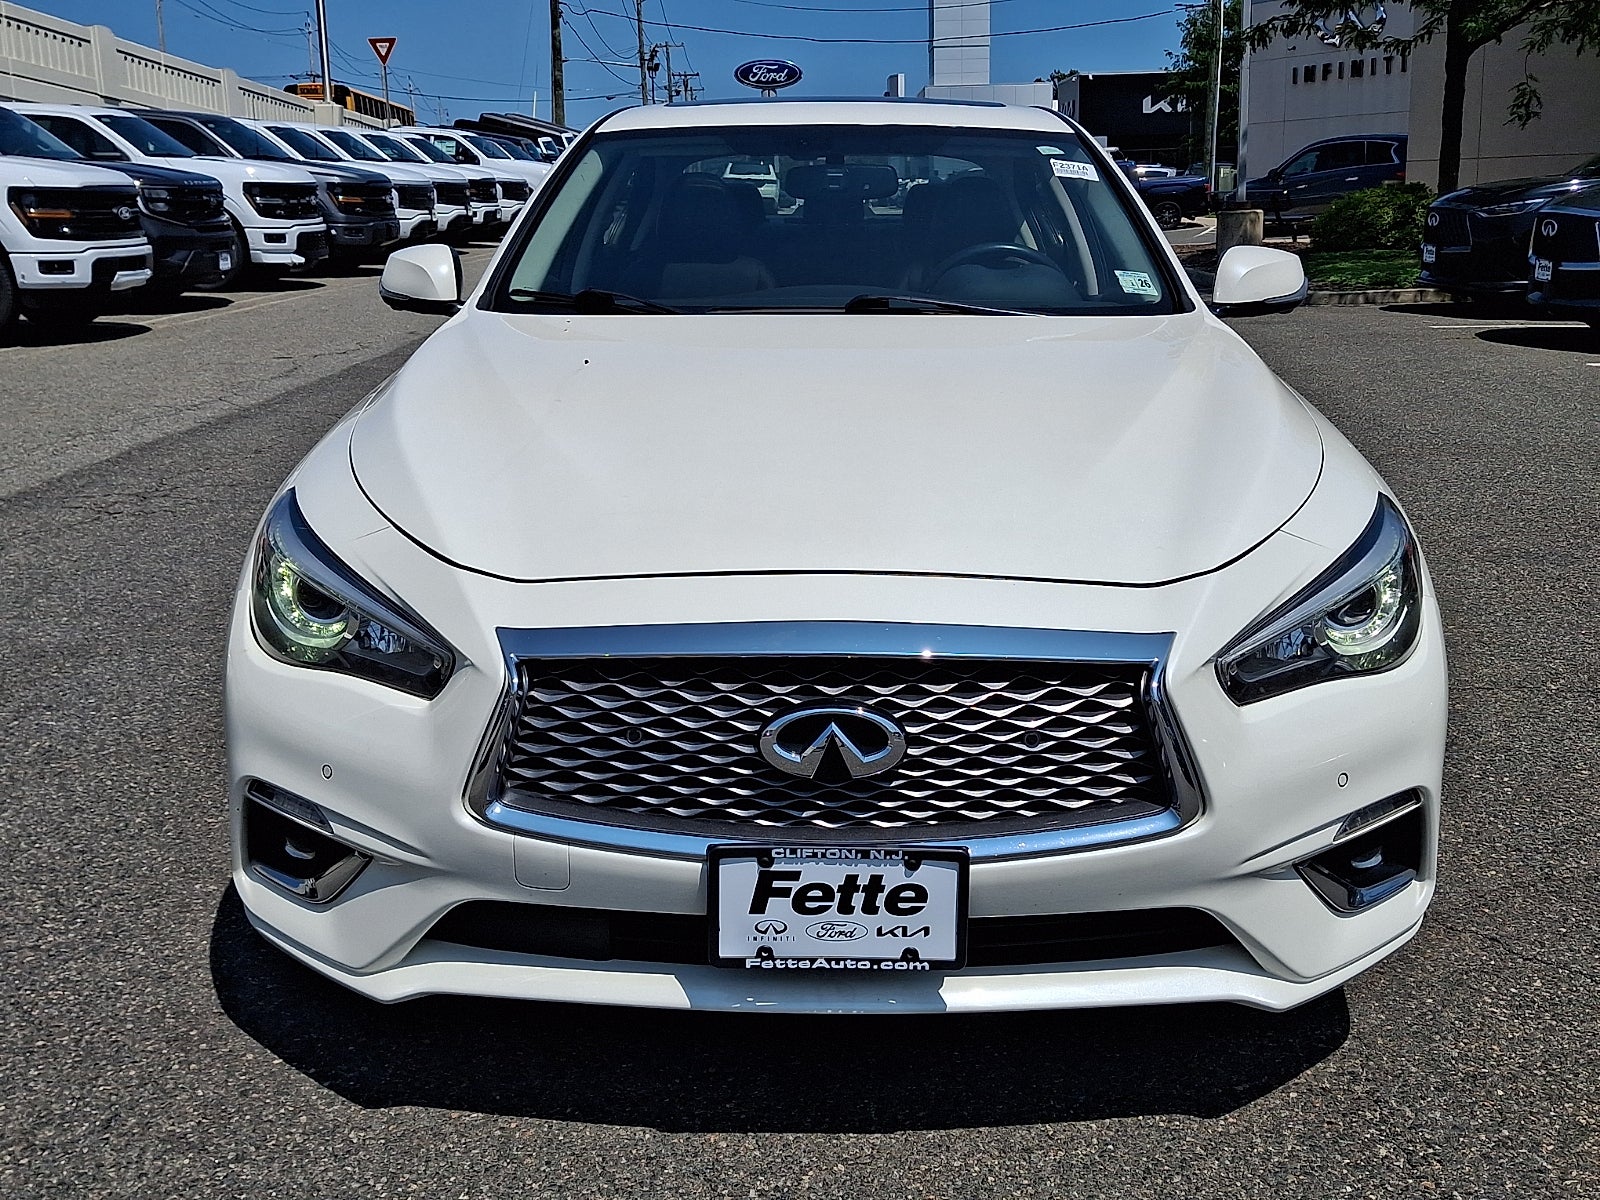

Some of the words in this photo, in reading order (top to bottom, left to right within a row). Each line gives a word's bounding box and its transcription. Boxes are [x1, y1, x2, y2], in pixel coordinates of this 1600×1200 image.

[748, 64, 788, 82] Ford
[1292, 54, 1408, 85] INFINITI
[1137, 279, 1151, 288] 26
[771, 848, 862, 860] CLIFTON,
[869, 850, 909, 860] N.J.
[748, 869, 929, 916] Fette
[815, 922, 858, 939] Ford
[745, 958, 930, 971] FetteAuto.com
